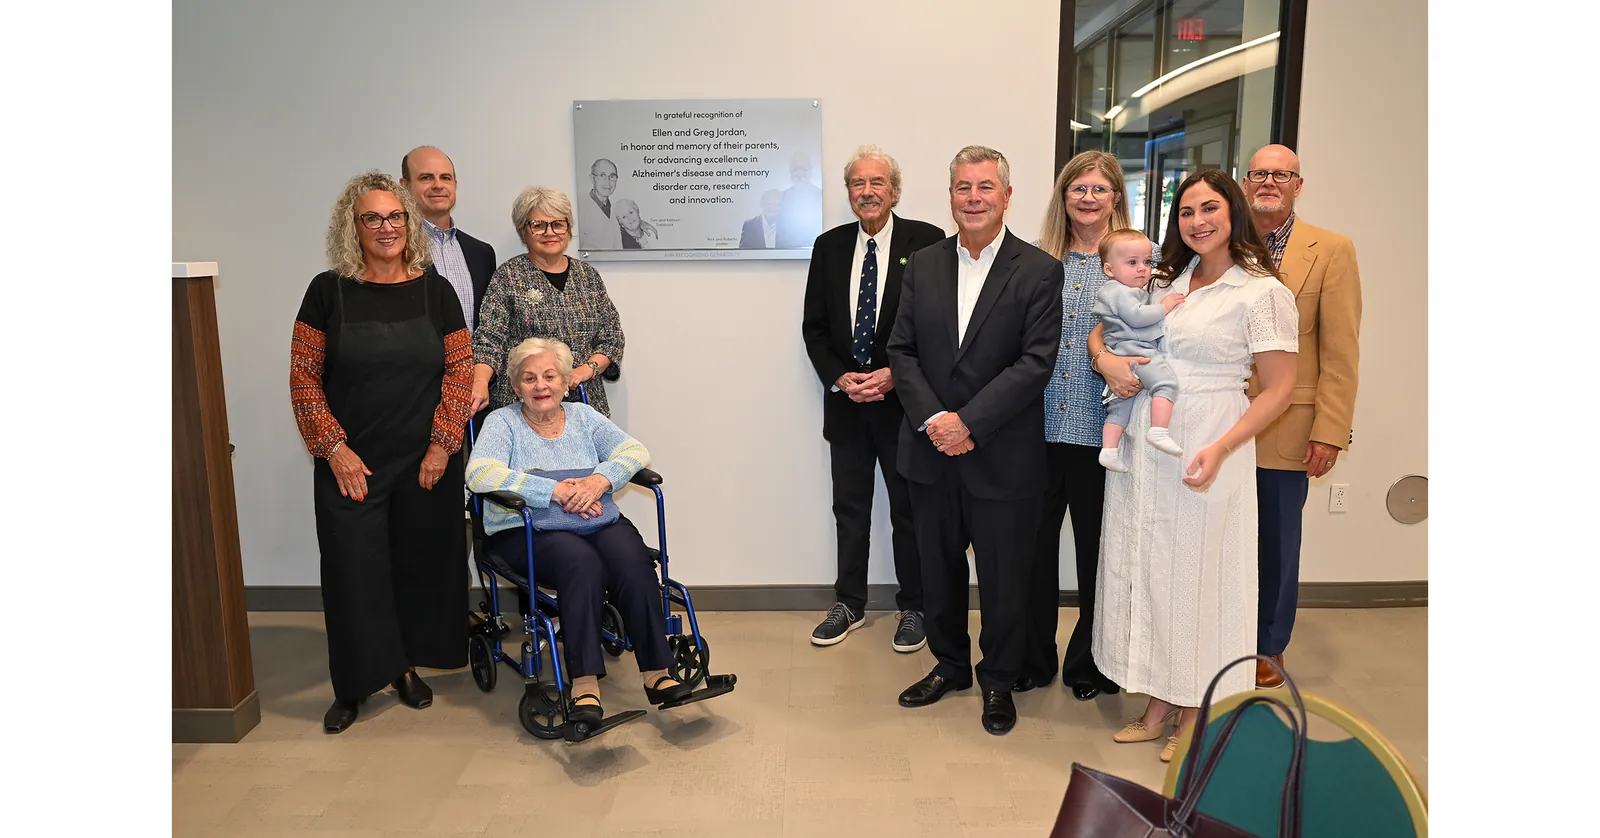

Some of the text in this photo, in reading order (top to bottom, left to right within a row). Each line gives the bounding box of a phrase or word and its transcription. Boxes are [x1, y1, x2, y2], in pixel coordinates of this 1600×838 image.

[663, 111, 692, 120] grateful
[693, 111, 734, 120] recognition
[652, 128, 747, 138] Ellen and Greg Jordan,
[630, 142, 655, 150] honor
[657, 142, 674, 150] and
[676, 143, 711, 152] memory
[713, 142, 722, 150] of
[723, 141, 743, 150] their
[745, 142, 780, 151] parents,
[643, 155, 758, 165] for advancing excellence in
[632, 169, 770, 178] Alzheimer's disease and memory
[652, 182, 750, 192] disorder care, research
[669, 195, 734, 204] and innovation.
